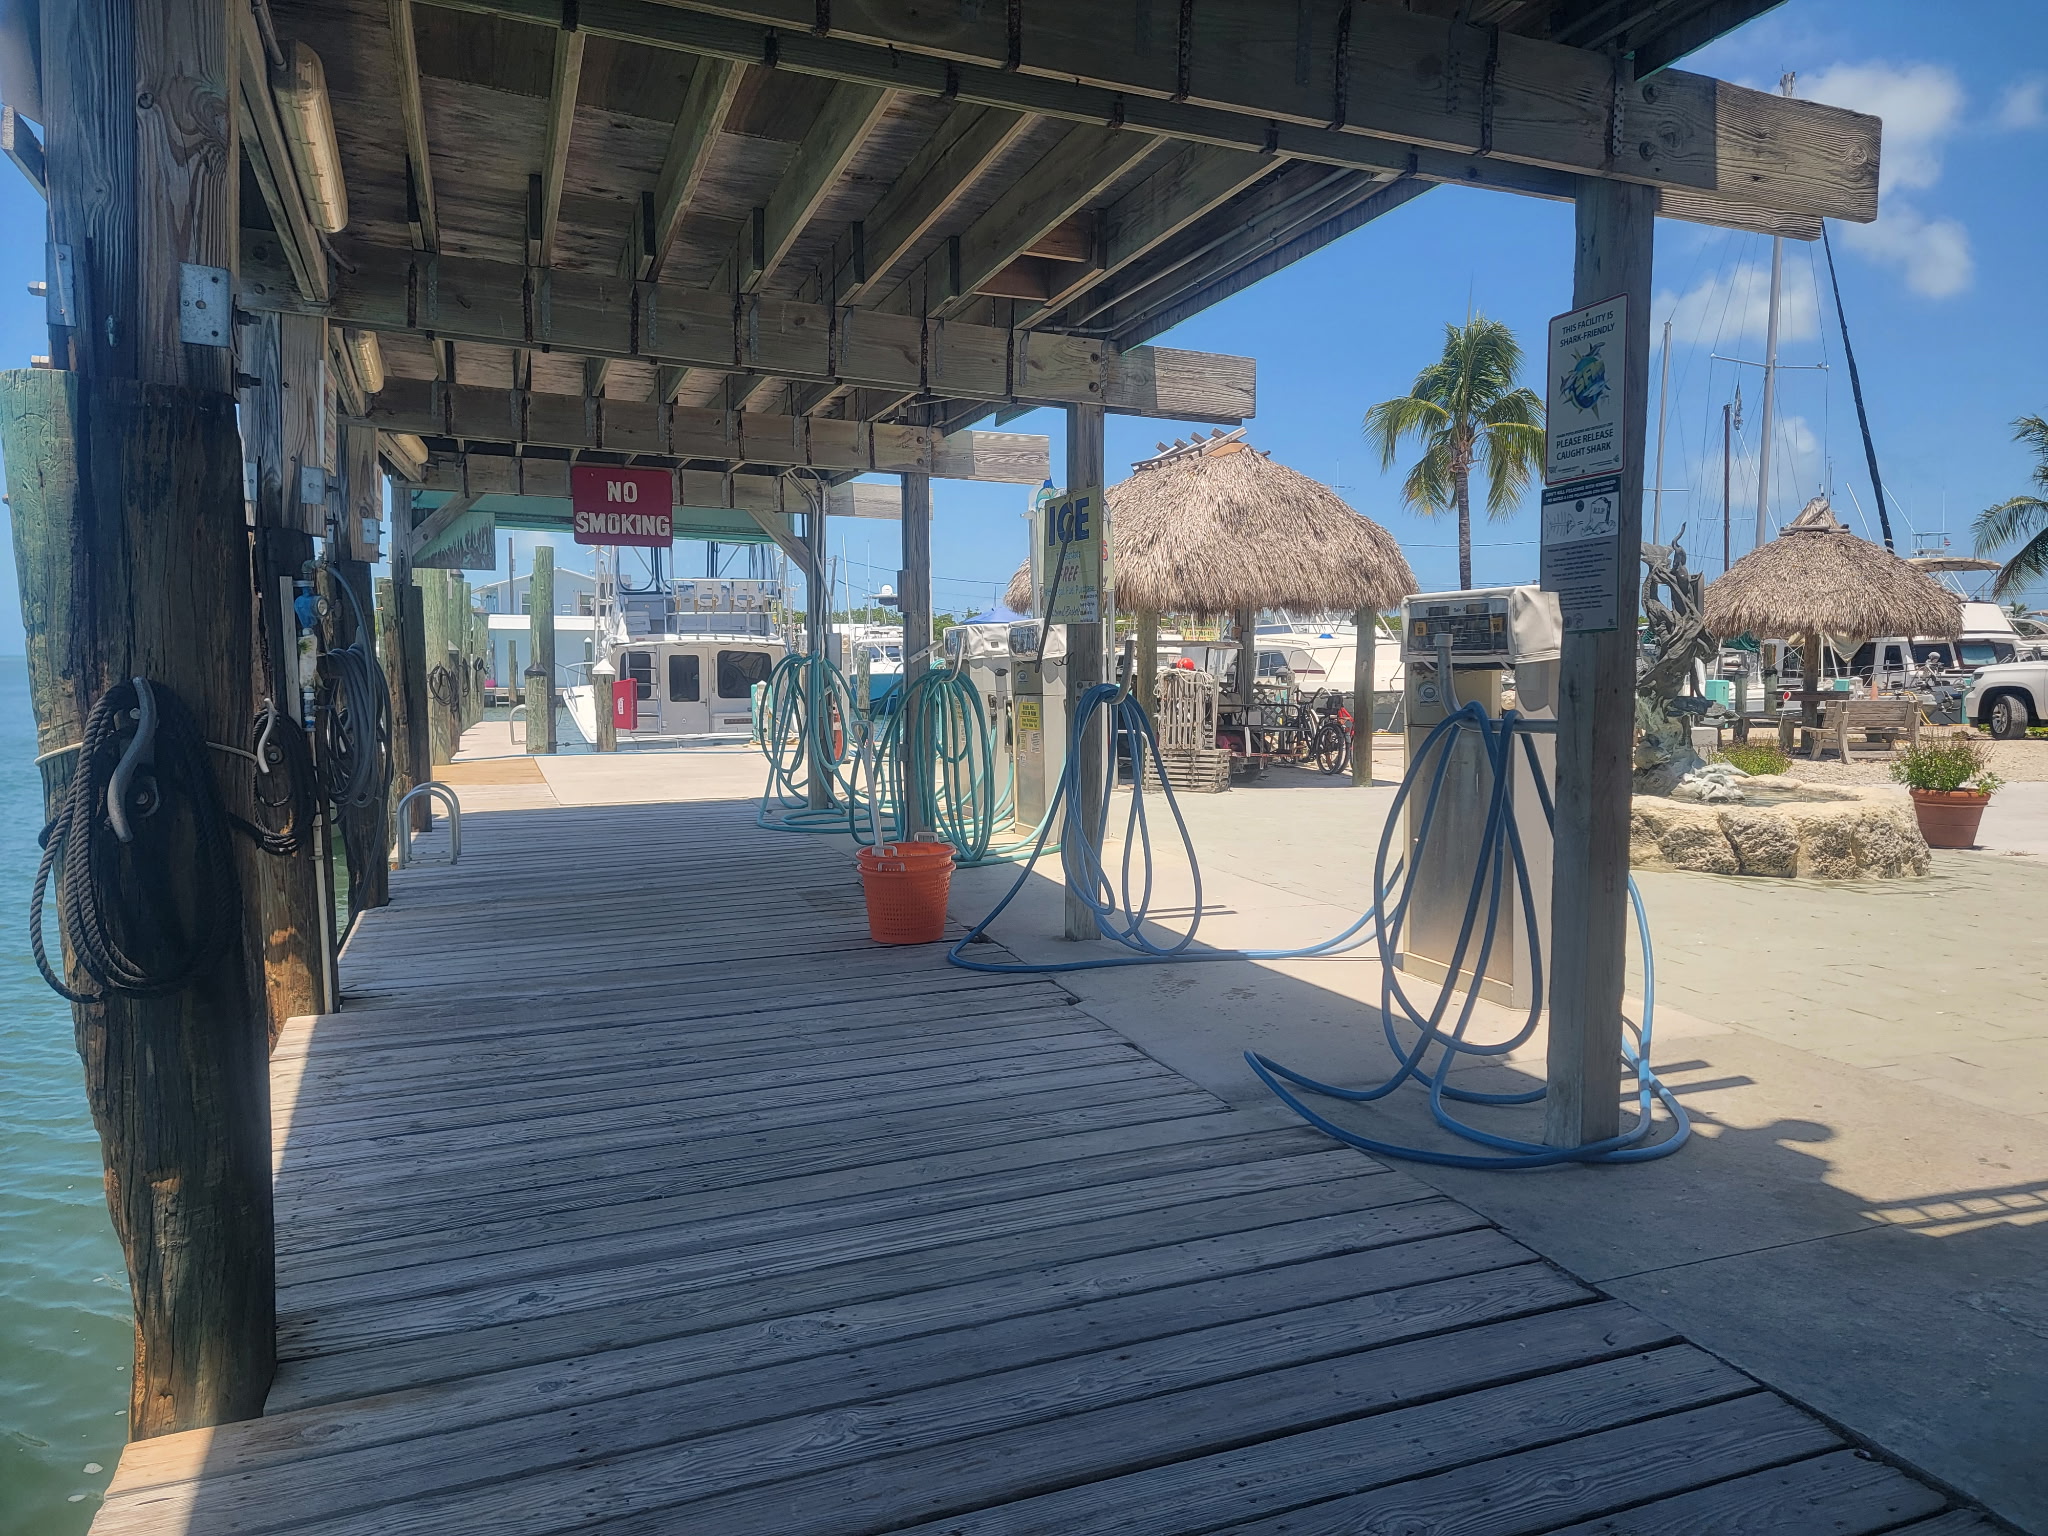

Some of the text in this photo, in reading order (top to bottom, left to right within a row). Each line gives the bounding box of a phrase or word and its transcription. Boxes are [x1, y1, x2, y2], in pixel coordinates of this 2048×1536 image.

[1559, 322, 1615, 348] SHARK-FRIENDLY
[1562, 310, 1614, 336] THIS FACILITY IS
[1556, 435, 1582, 449] PLEASE
[1582, 428, 1614, 443] RELEASE
[1556, 441, 1612, 461] CAUGHT SHARK
[607, 480, 638, 503] NO
[575, 511, 671, 537] SMOKING
[1048, 497, 1090, 547] ICE
